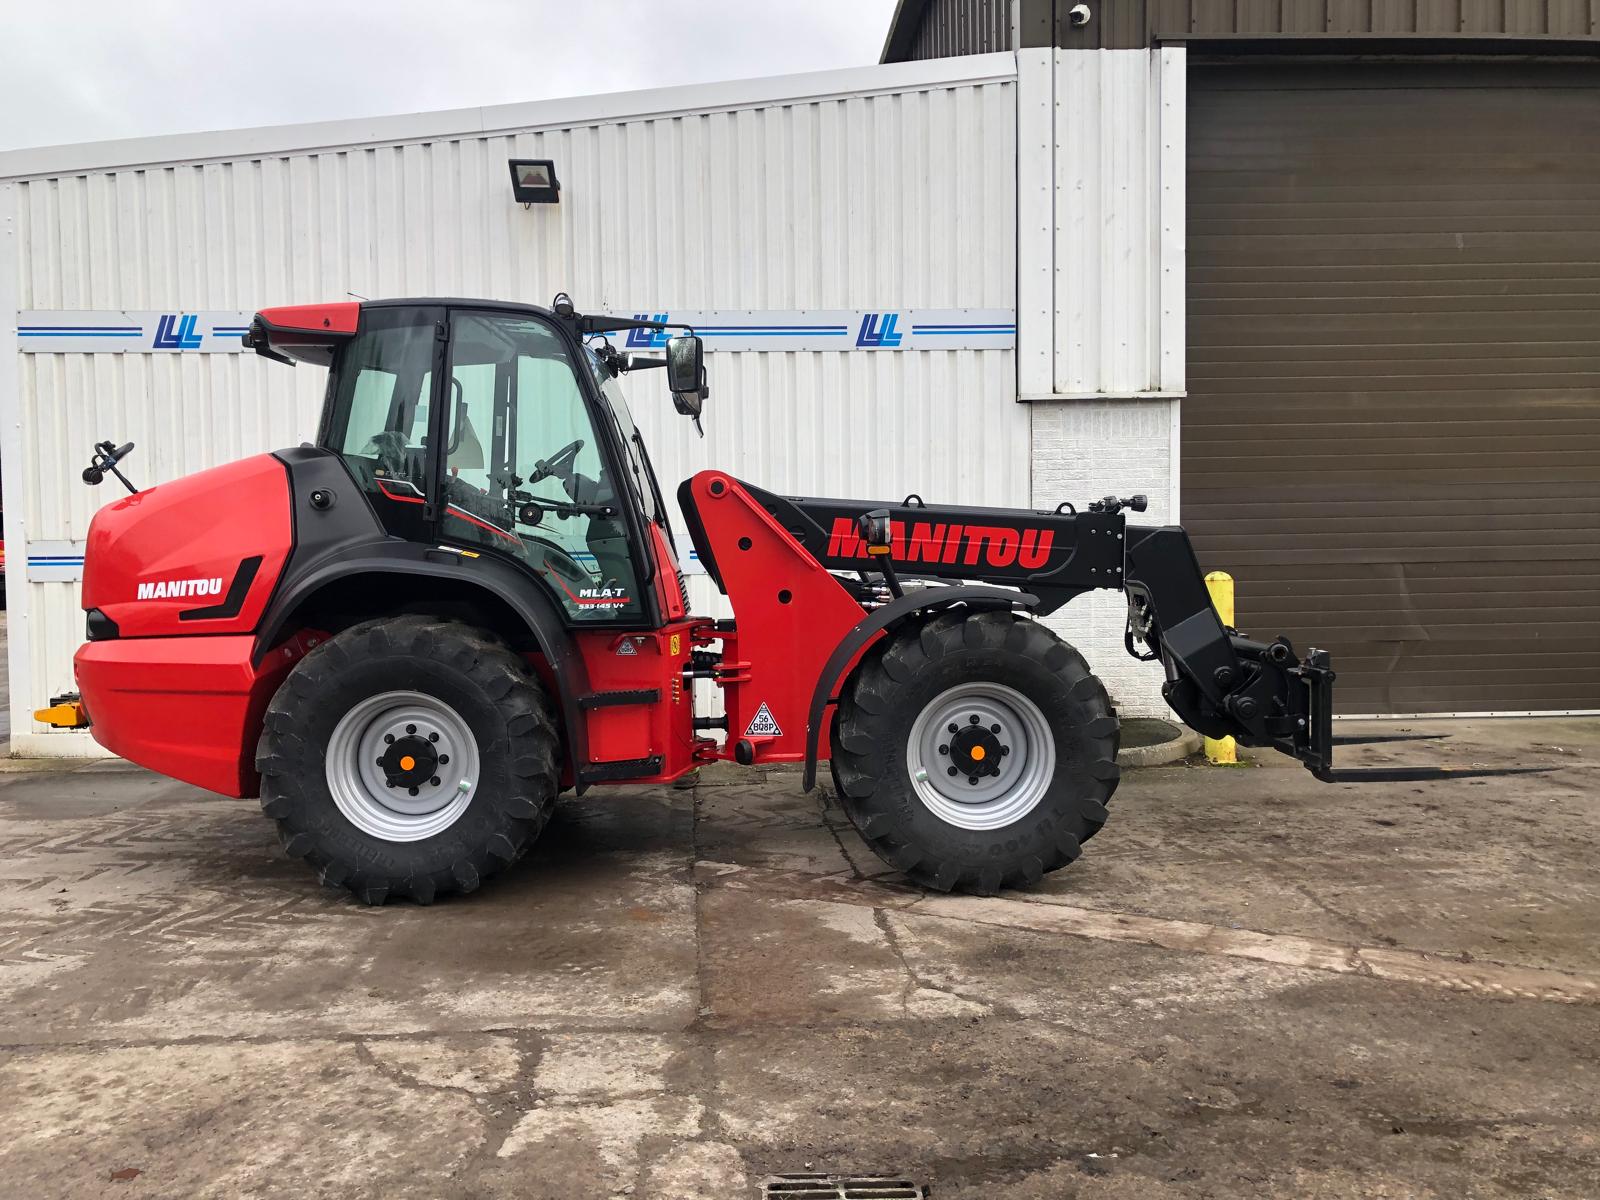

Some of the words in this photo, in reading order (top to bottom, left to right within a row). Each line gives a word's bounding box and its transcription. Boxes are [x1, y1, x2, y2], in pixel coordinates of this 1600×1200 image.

[137, 577, 223, 600] MANITOU
[579, 587, 625, 598] MLA-T
[758, 714, 769, 723] 56
